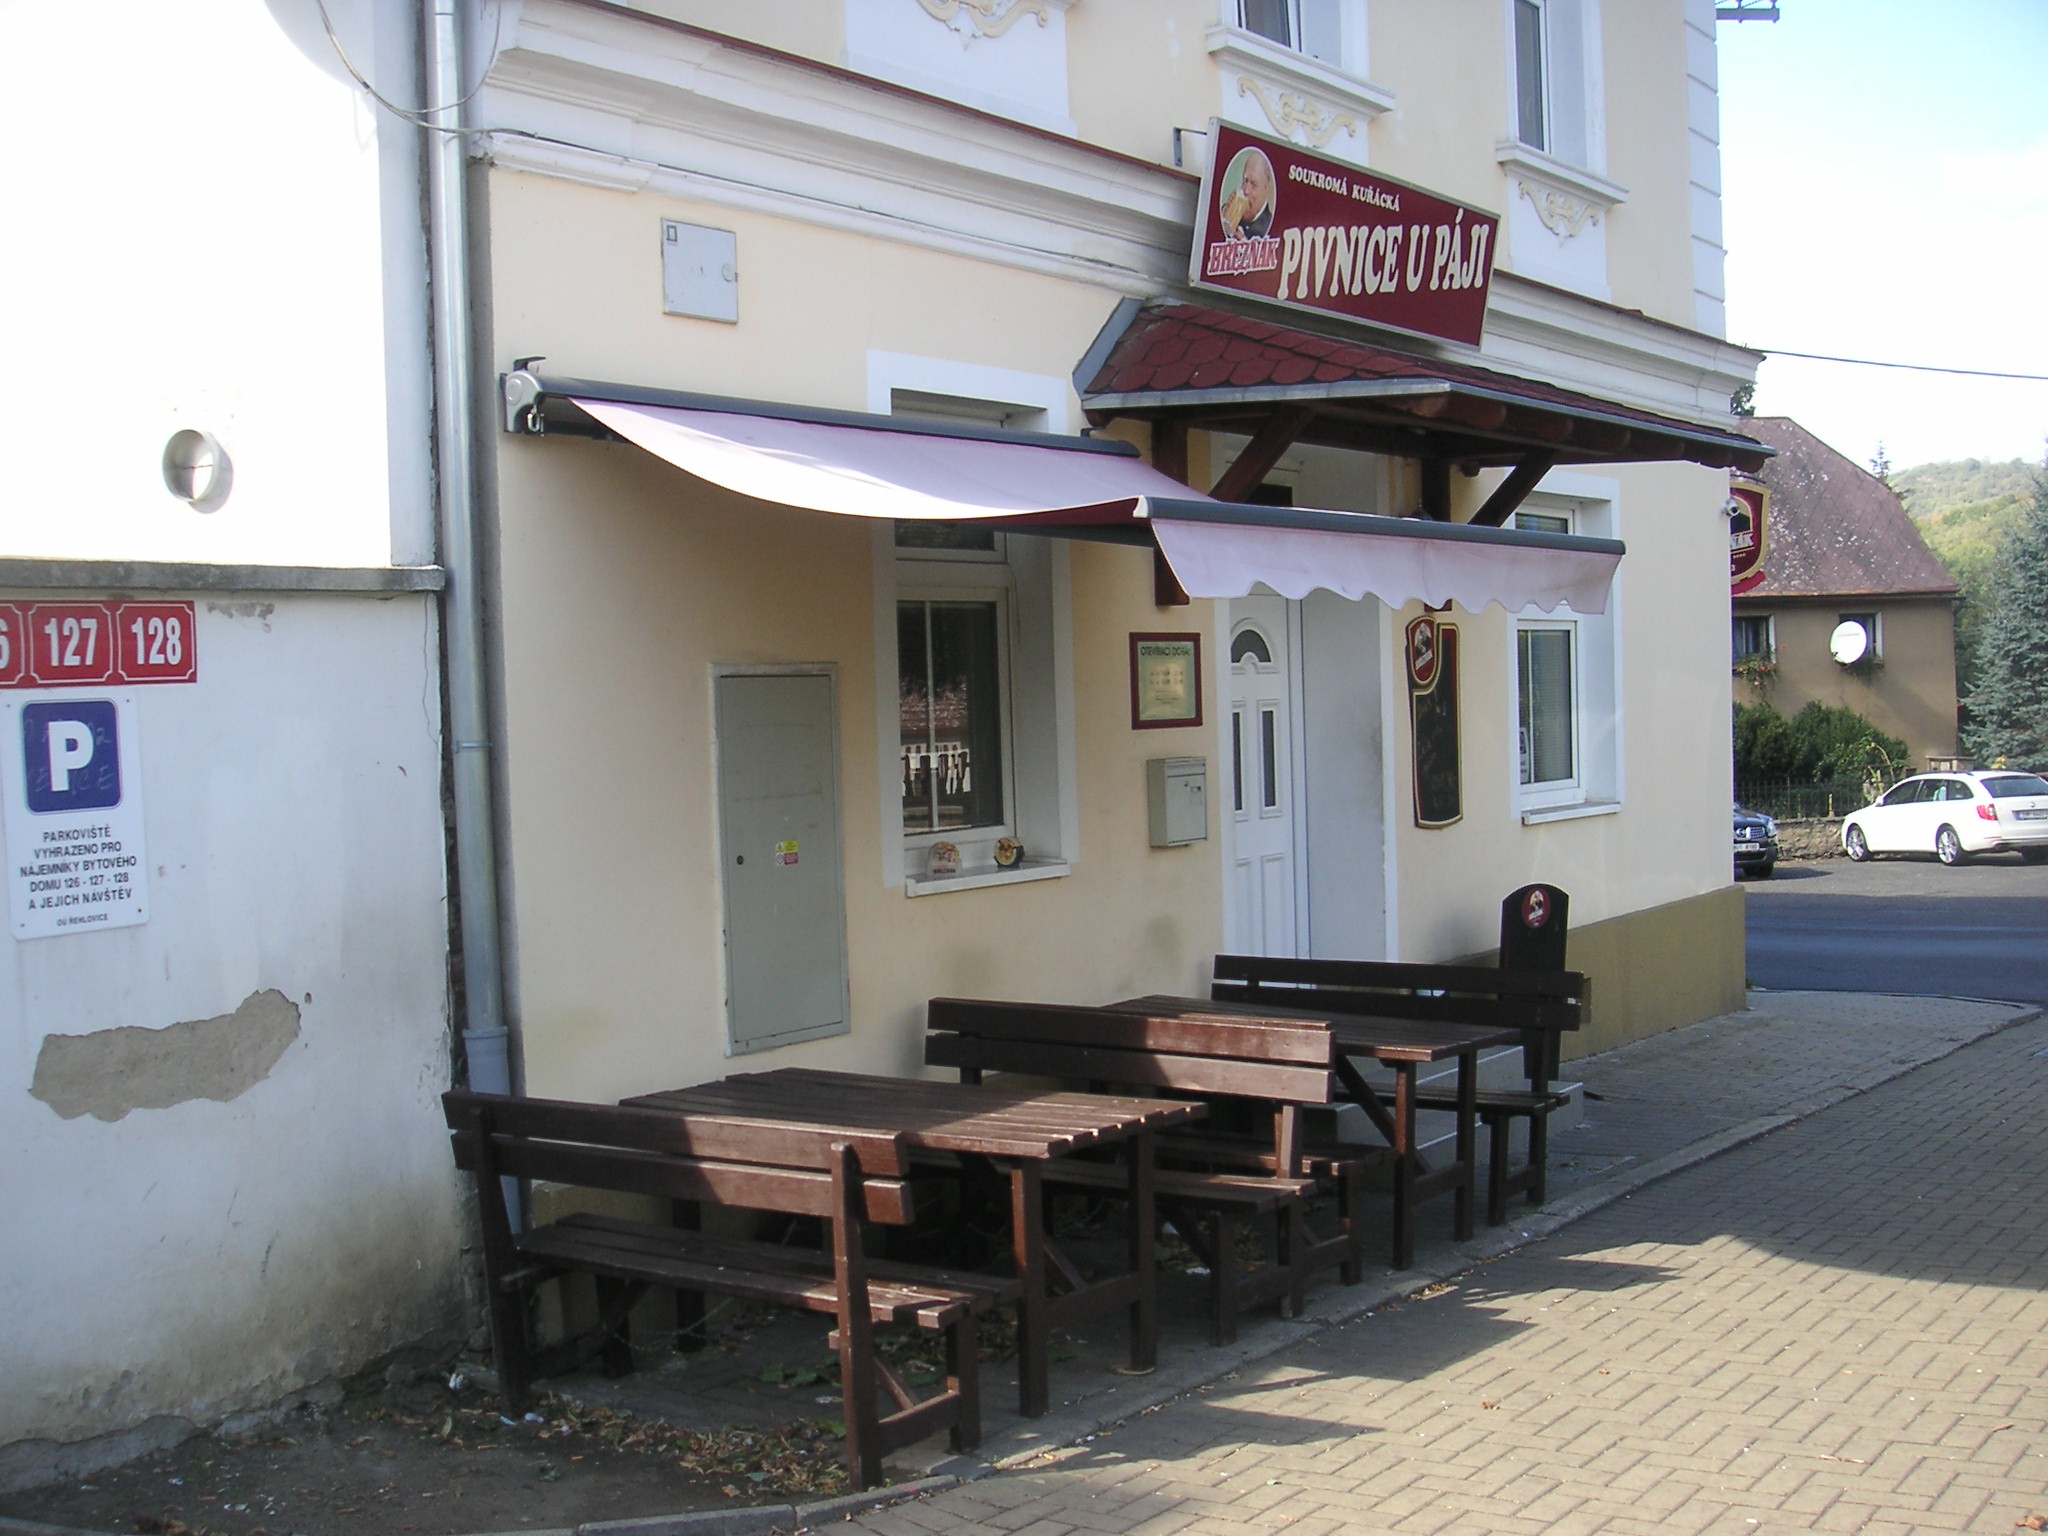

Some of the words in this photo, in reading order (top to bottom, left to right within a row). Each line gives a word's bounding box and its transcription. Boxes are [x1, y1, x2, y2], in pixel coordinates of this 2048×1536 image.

[1288, 164, 1348, 197] SOUKROMÁ
[1351, 183, 1400, 212] KUŘÁCKÁ
[1277, 224, 1403, 300] PIVNICE
[1406, 224, 1430, 293] U
[1429, 207, 1490, 291] PÁJI
[44, 617, 98, 667] 127
[131, 616, 182, 666] 128
[48, 720, 94, 792] P
[43, 824, 112, 843] PARKOVIŠTĚ
[34, 843, 99, 860] VYHRAZENO
[101, 841, 122, 854] PRO
[20, 860, 80, 878] NÁJEMNÍKY
[83, 854, 137, 872] BYTOVÉHO
[30, 878, 62, 893] DOMU
[64, 877, 80, 889] 126
[89, 874, 105, 887] 127
[113, 872, 129, 884] 128
[28, 899, 37, 910] A
[40, 894, 80, 909] JEJICH
[82, 886, 133, 904] NÁVŠTĚV
